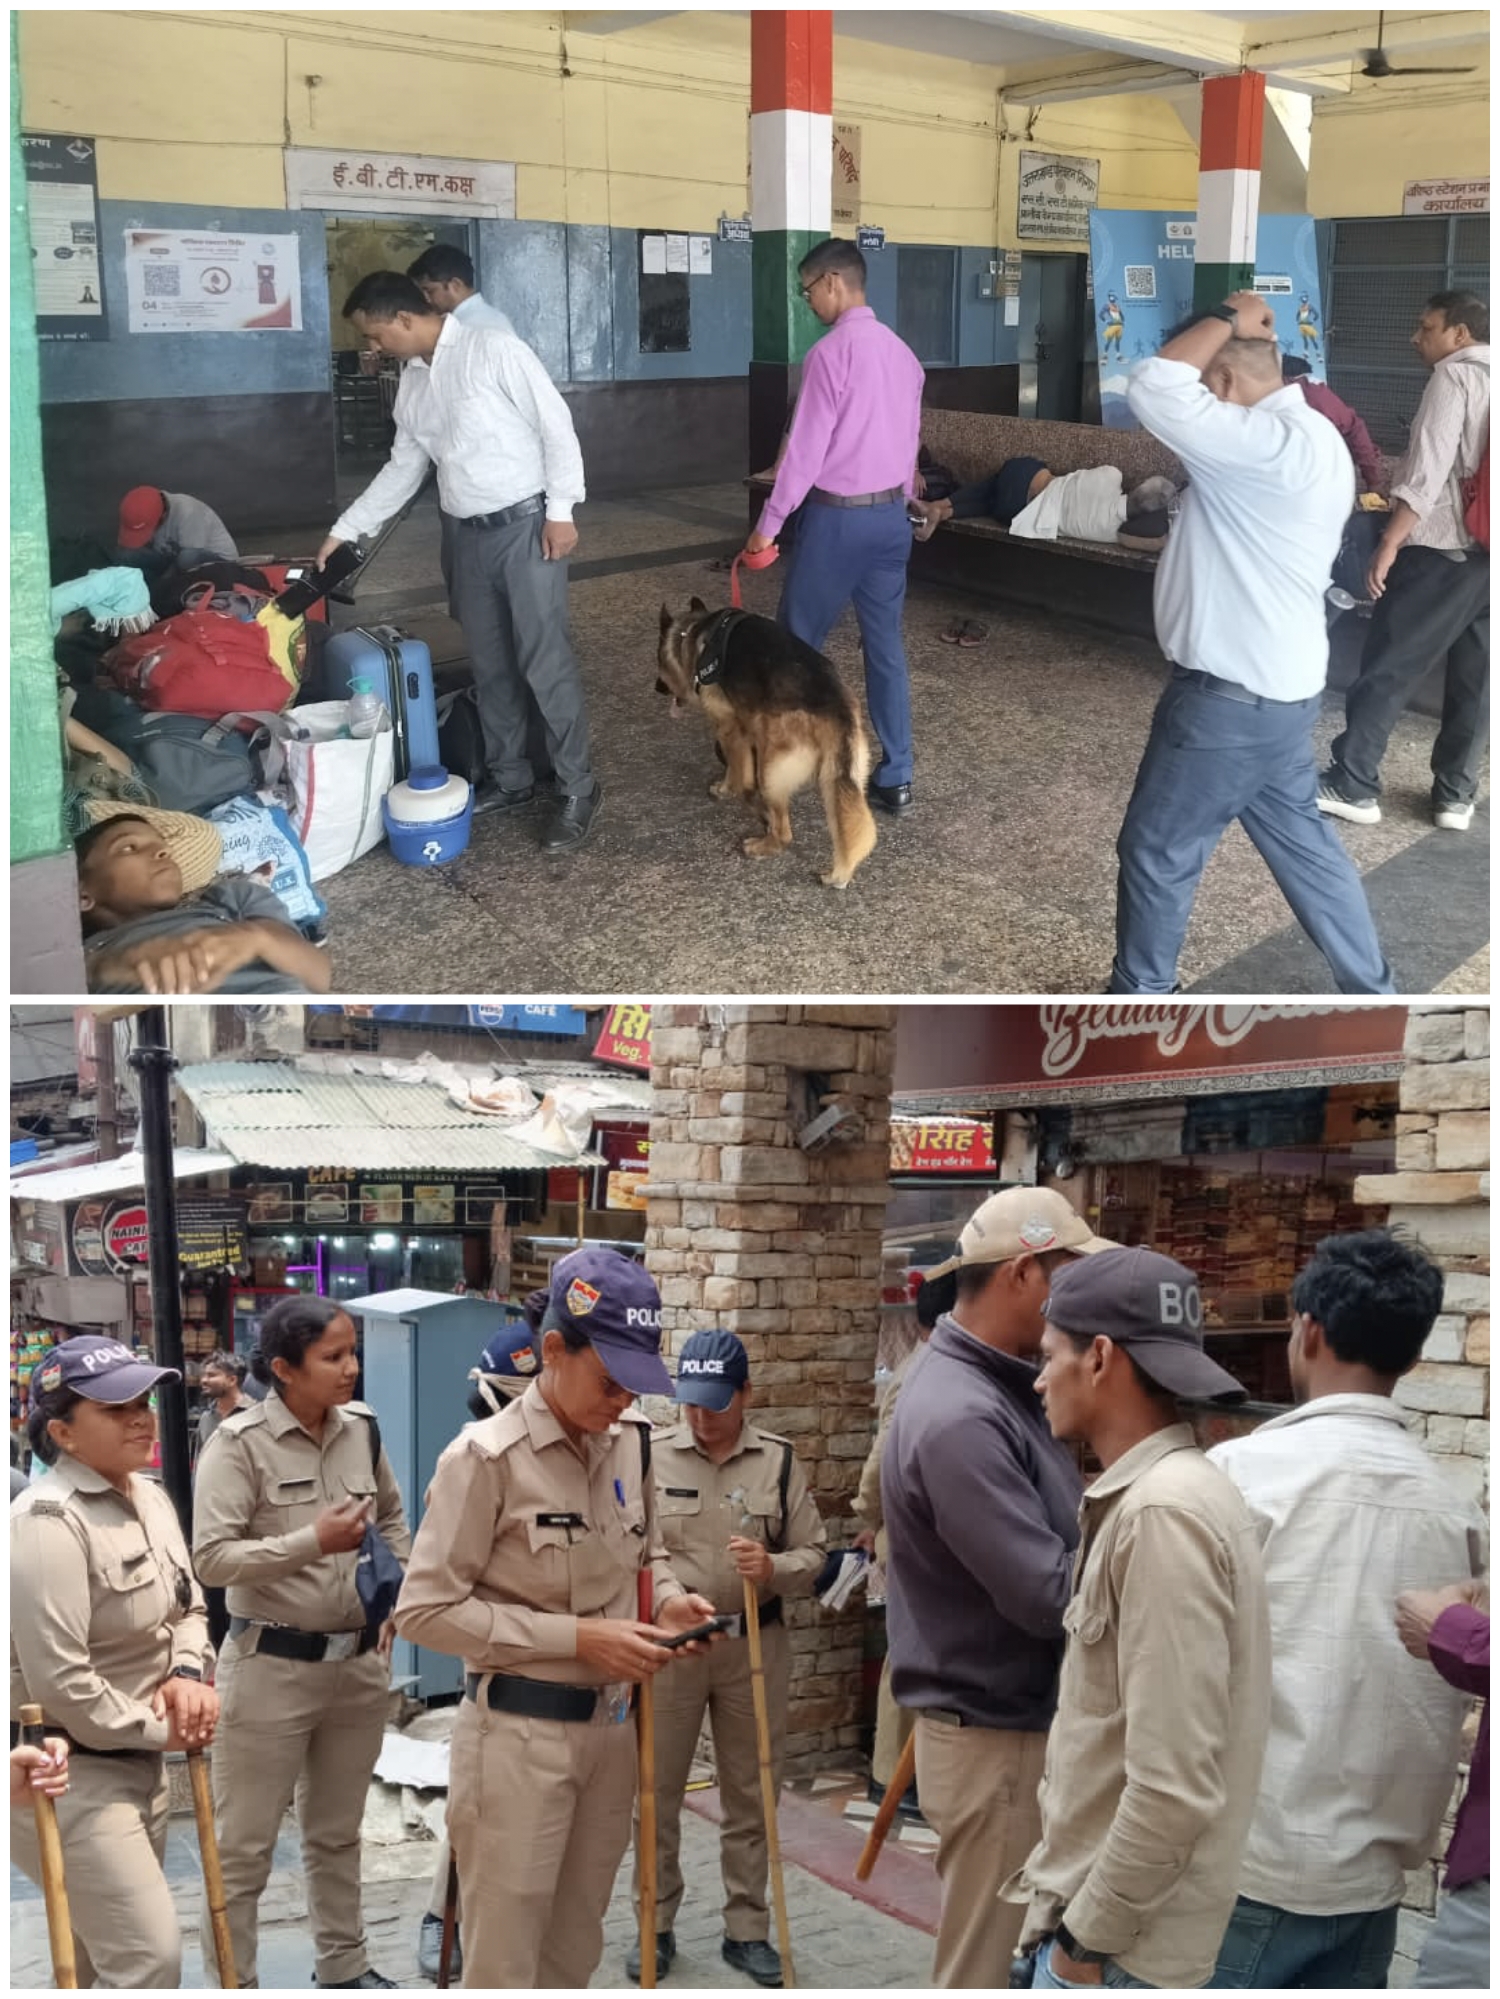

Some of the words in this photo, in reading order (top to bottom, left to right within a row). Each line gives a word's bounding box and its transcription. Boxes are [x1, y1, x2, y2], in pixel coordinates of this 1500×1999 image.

[1423, 196, 1487, 212] कार्यालय
[142, 301, 157, 310] 04
[613, 1040, 643, 1063] Veg.
[682, 1360, 724, 1374] POLICE
